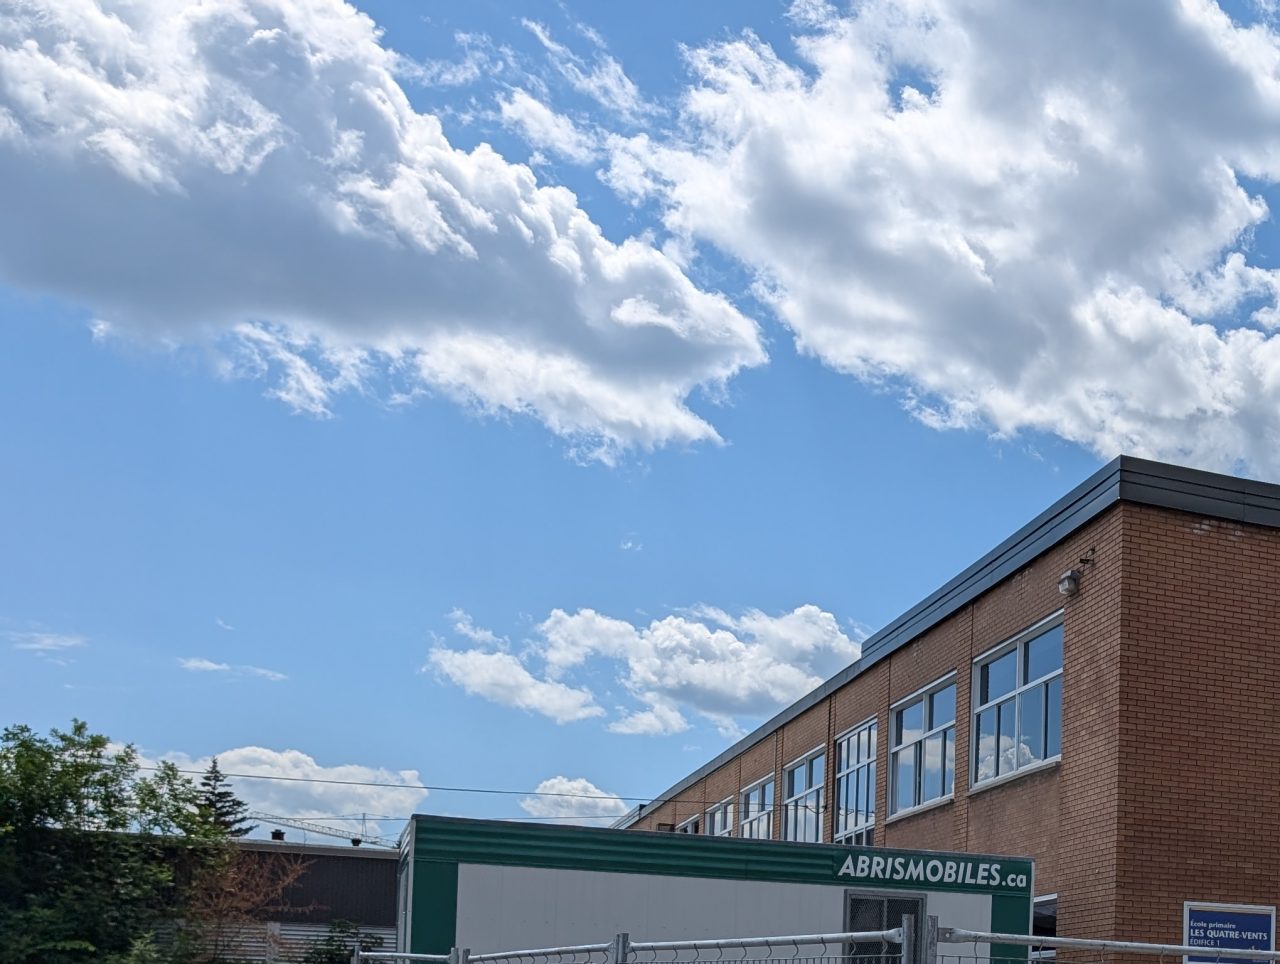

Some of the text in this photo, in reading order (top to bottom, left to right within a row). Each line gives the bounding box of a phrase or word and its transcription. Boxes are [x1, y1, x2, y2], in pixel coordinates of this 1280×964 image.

[837, 854, 1028, 888] ABRISMOBILES.ca
[1190, 919, 1236, 929] École primaire
[1190, 929, 1268, 940] LES QUATRE-VENTS
[1189, 937, 1215, 946] ÉDIFICE
